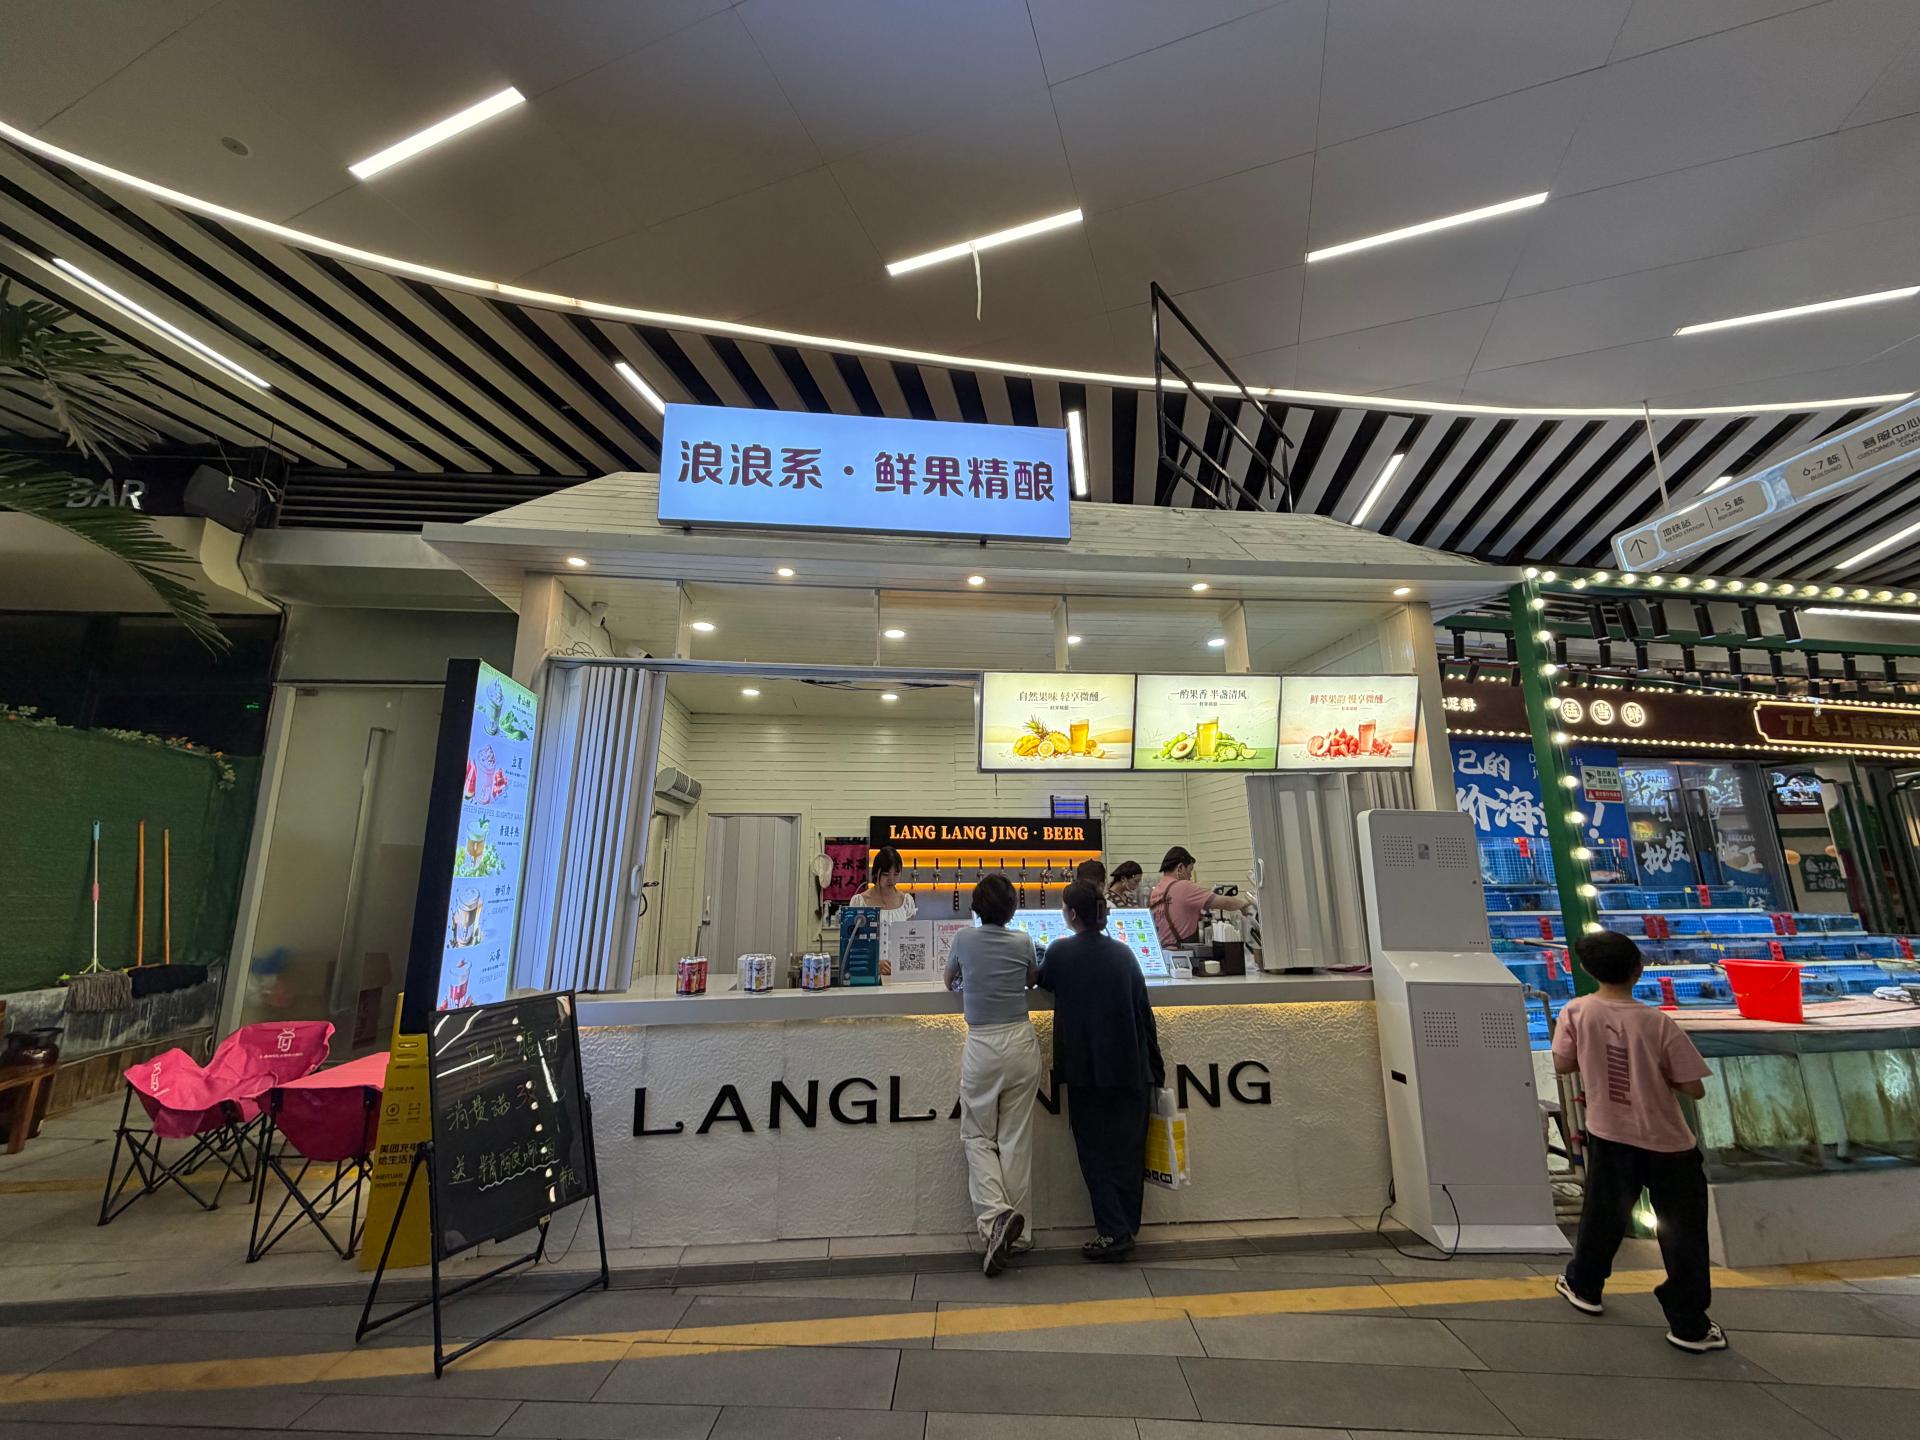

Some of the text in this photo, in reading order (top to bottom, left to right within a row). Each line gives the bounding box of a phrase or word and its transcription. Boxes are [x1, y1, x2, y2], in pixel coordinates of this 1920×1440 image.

[66, 478, 145, 509] BAR
[1662, 519, 1691, 537] 地铁站
[1019, 691, 1058, 702] 自然果味
[1170, 689, 1208, 699] 一酌果香
[1450, 749, 1510, 781] 己的
[889, 825, 1085, 842] LANG LANG JING BEER
